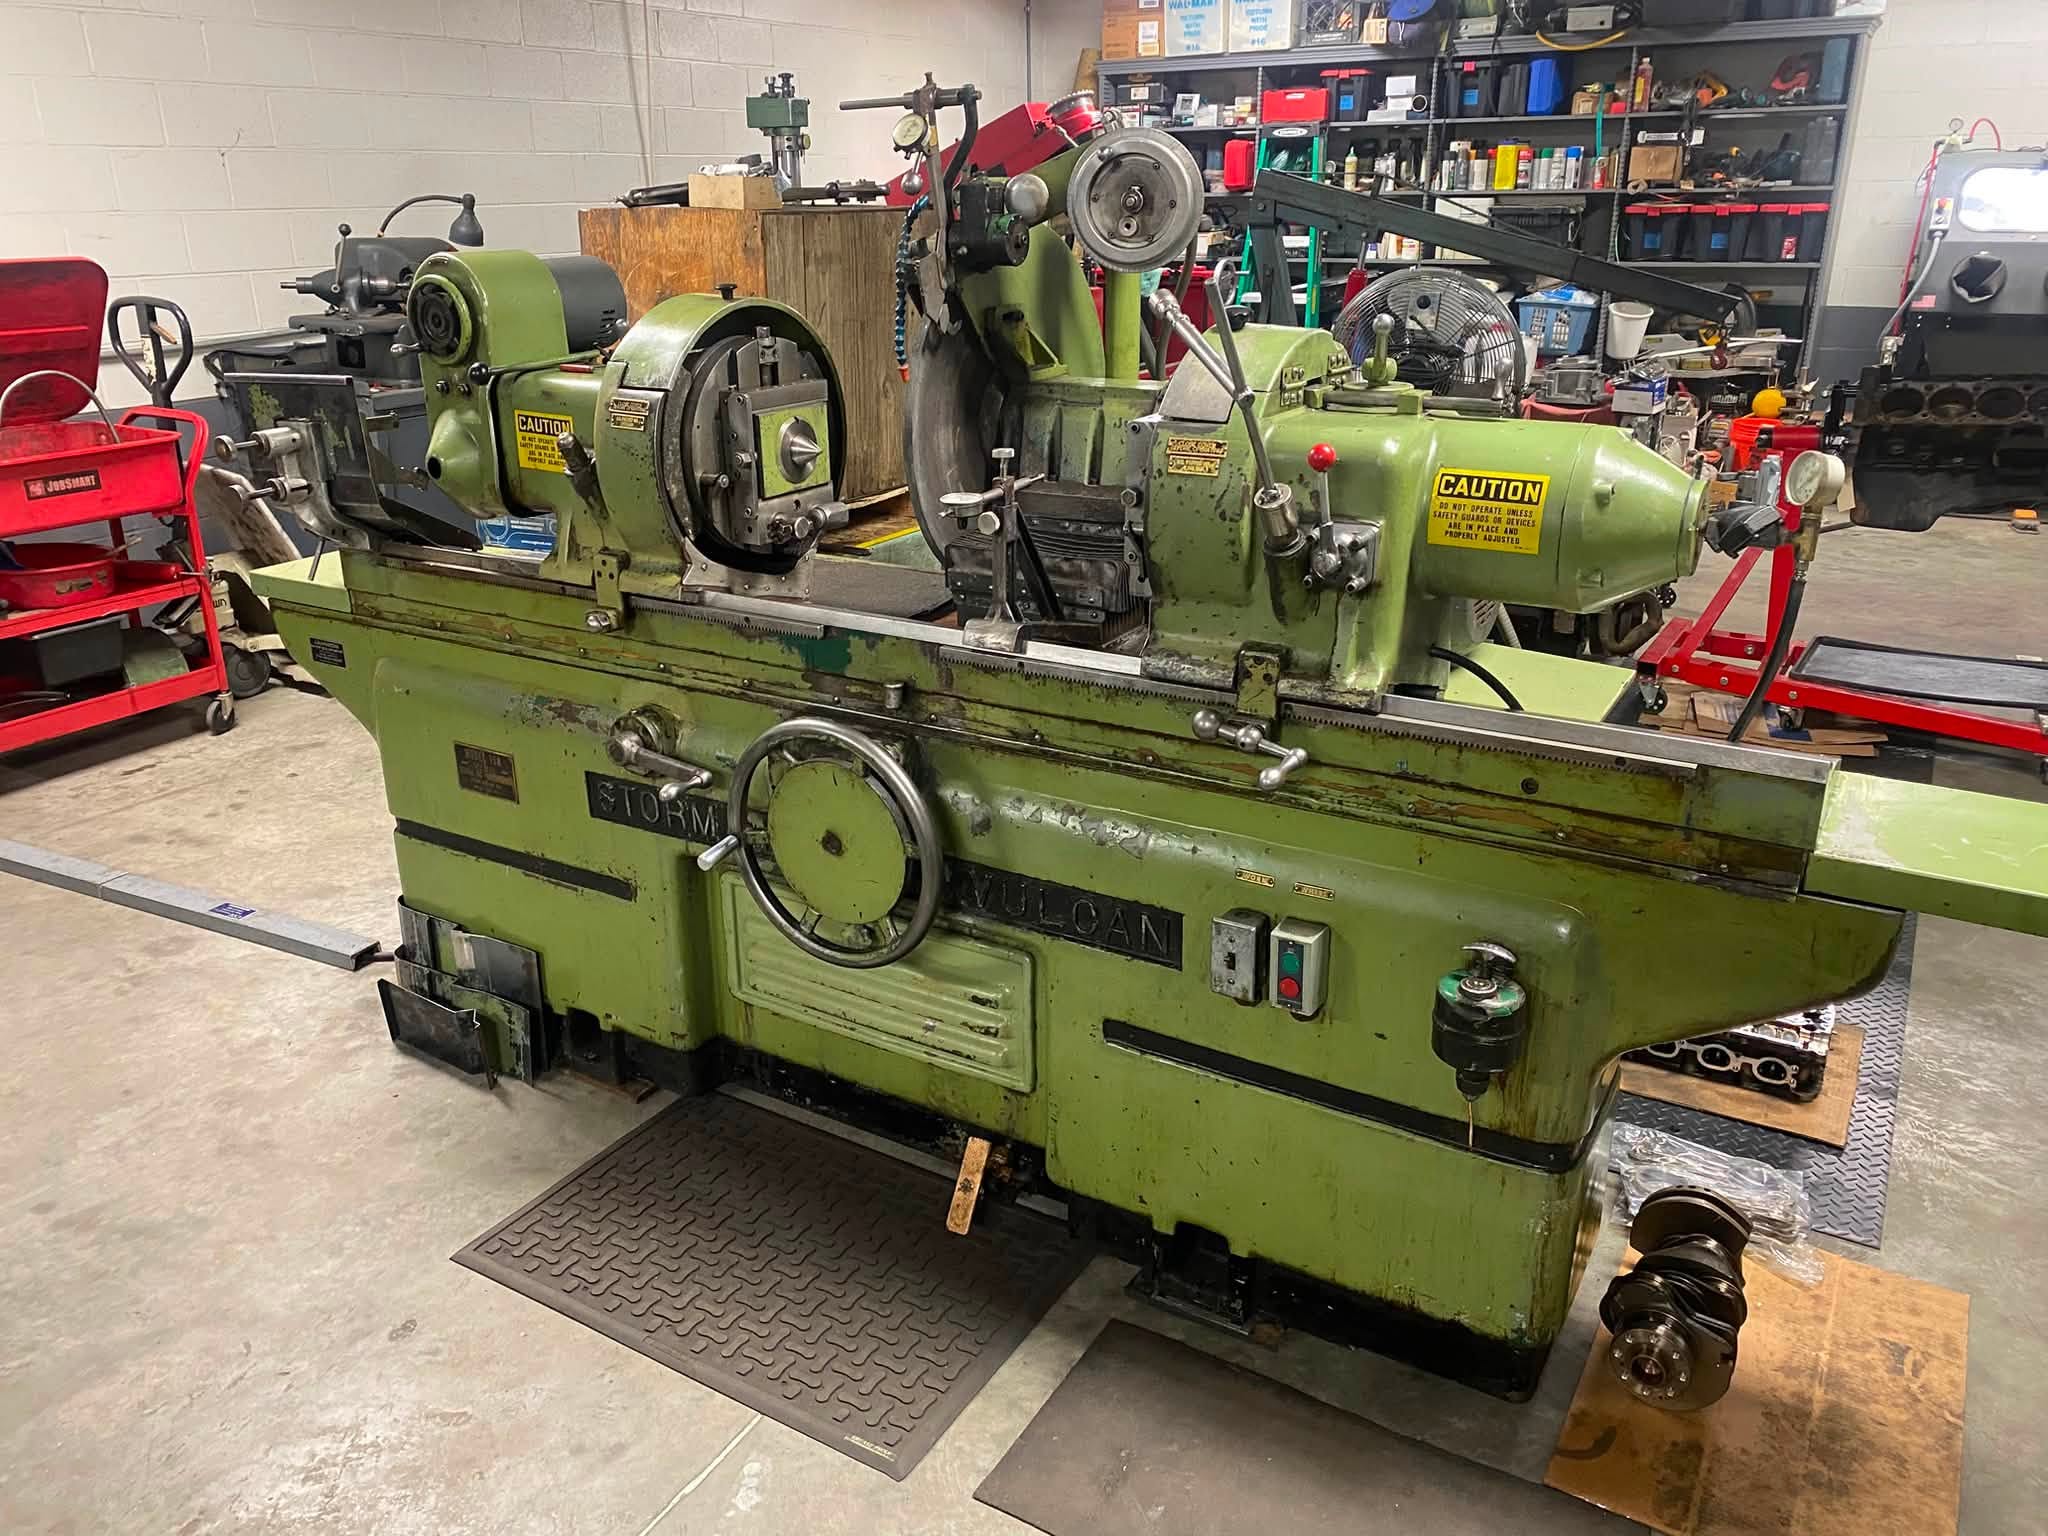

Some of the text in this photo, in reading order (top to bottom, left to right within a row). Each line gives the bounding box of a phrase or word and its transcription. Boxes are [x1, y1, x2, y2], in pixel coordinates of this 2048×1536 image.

[518, 415, 570, 436] CAUTION
[1439, 475, 1541, 503] CAUTION
[1439, 501, 1534, 518] DO NOT OPERATE UNLESS
[1433, 511, 1536, 527] SAFETY GUARDS OR DEVICES
[1444, 530, 1520, 545] PROPERLY ADJUSTED
[1448, 522, 1519, 536] ARE IN PLACE AND
[598, 780, 1172, 958] STORM VULCAN
